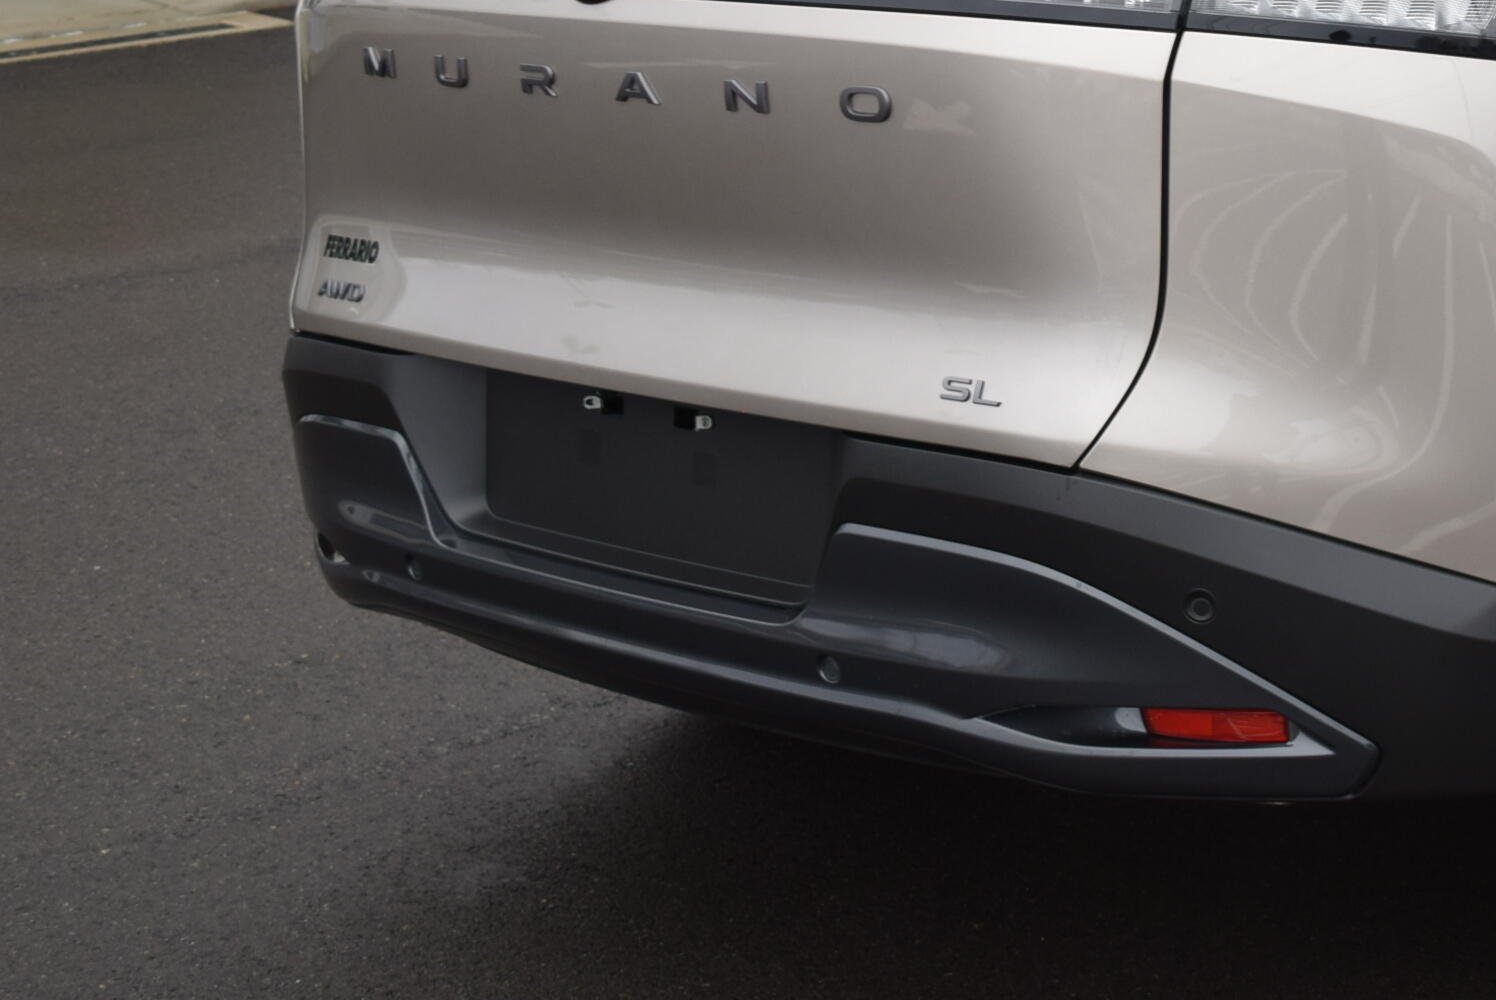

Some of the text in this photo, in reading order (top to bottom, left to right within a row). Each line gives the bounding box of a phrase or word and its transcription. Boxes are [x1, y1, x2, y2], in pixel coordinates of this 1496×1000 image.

[362, 46, 893, 123] MURANO
[323, 234, 379, 264] FERRARIO
[317, 280, 366, 303] AWD
[940, 376, 1002, 408] SL
